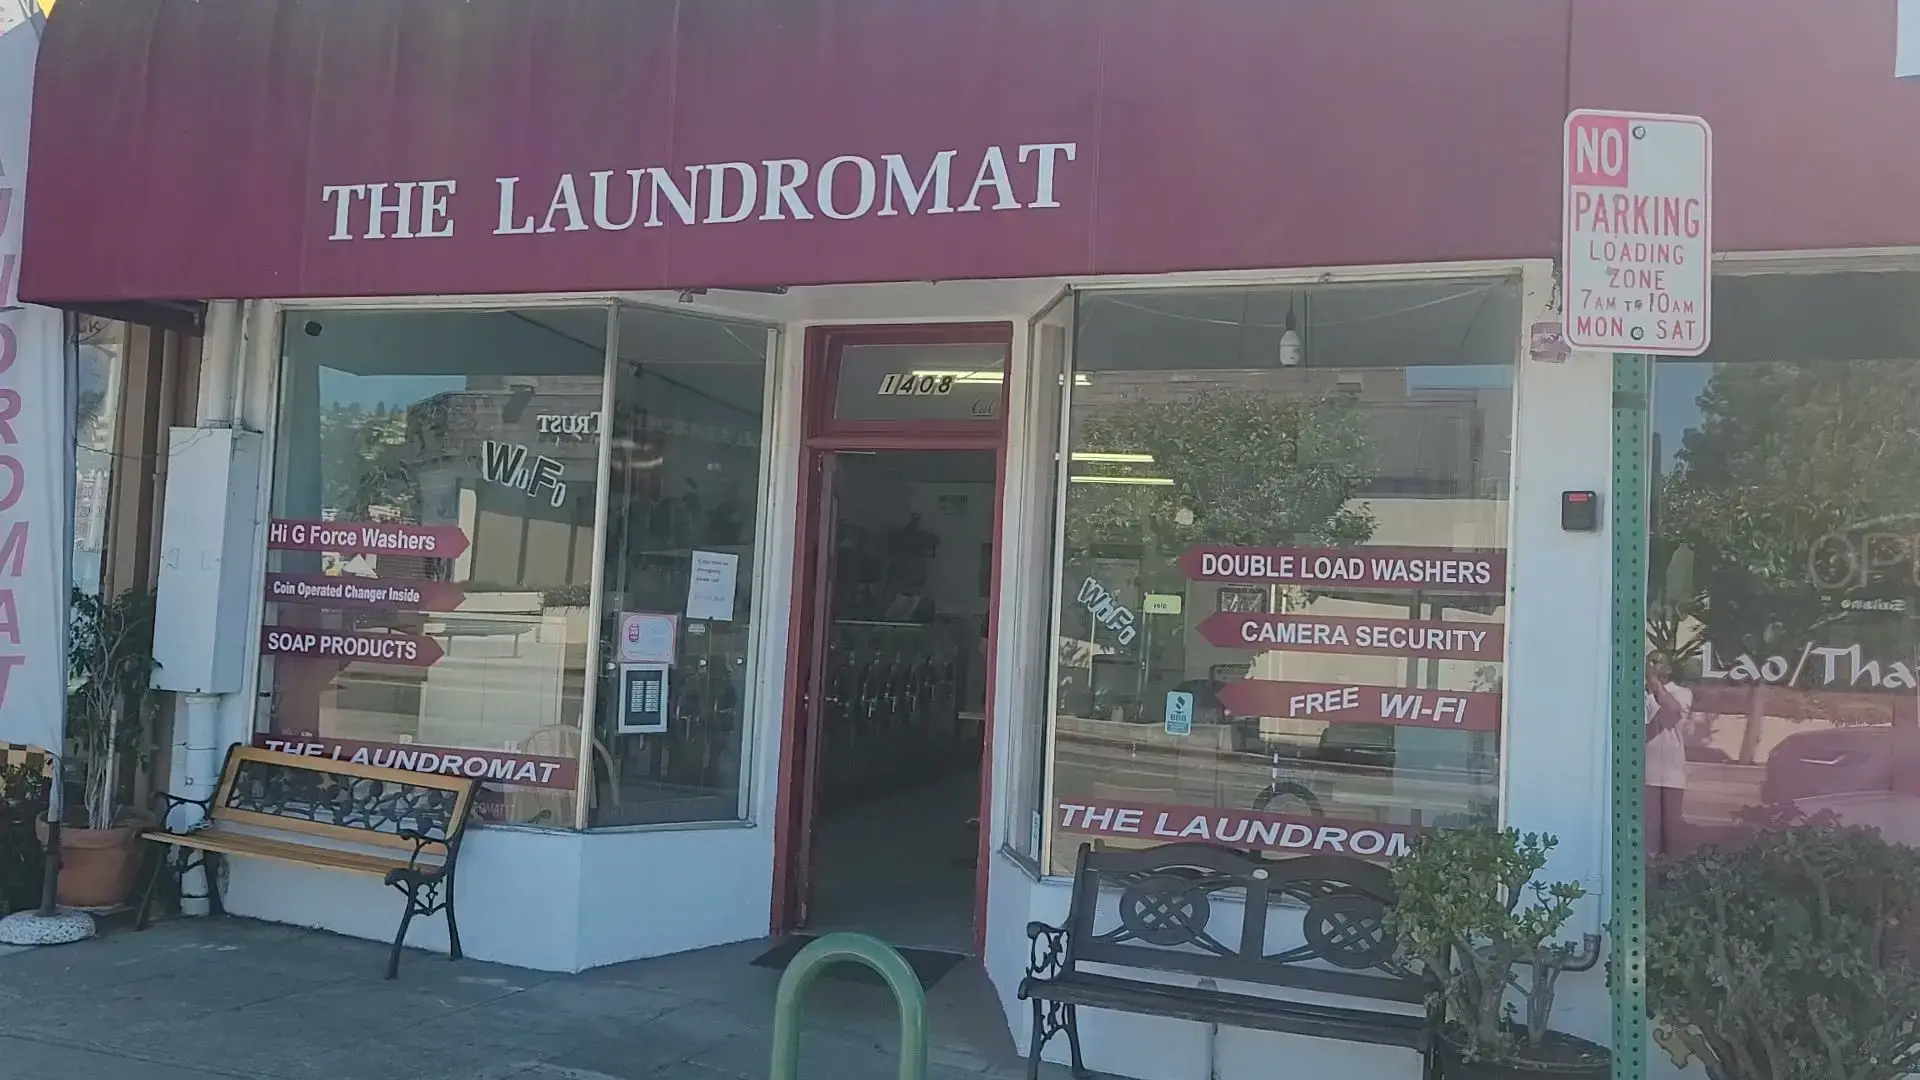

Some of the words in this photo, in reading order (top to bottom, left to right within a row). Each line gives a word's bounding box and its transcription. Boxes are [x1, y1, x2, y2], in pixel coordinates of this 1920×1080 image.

[1576, 126, 1623, 177] NO
[322, 180, 456, 241] THE
[492, 142, 1077, 236] LAUNDROMAT
[1575, 191, 1700, 238] PARKING
[1589, 240, 1684, 265] LOADING
[1608, 268, 1666, 291] ZONE
[1576, 316, 1623, 337] MON
[1656, 320, 1696, 341] SAT
[884, 375, 955, 394] 1408
[270, 523, 287, 542] Hi
[291, 524, 306, 544] G
[310, 525, 357, 546] Force
[362, 527, 436, 550] Washers
[1201, 552, 1294, 579] DOUBLE
[1300, 556, 1365, 580] LOAD
[1371, 559, 1491, 584] WASHERS
[1808, 532, 1920, 590] OP
[273, 581, 295, 595] Coin
[298, 582, 342, 599] Operated
[345, 584, 387, 602] Changer
[389, 587, 420, 602] Inside
[268, 632, 316, 653] SOAP
[320, 636, 417, 660] PRODUCTS
[1241, 621, 1349, 646] CAMERA
[1356, 625, 1487, 652] SECURITY
[1697, 641, 1920, 689] Lao/Tha
[1289, 686, 1360, 717] FREE
[1380, 692, 1467, 723] WI-FI
[1059, 803, 1144, 833] THE
[1153, 812, 1412, 857] LAUNDROM
